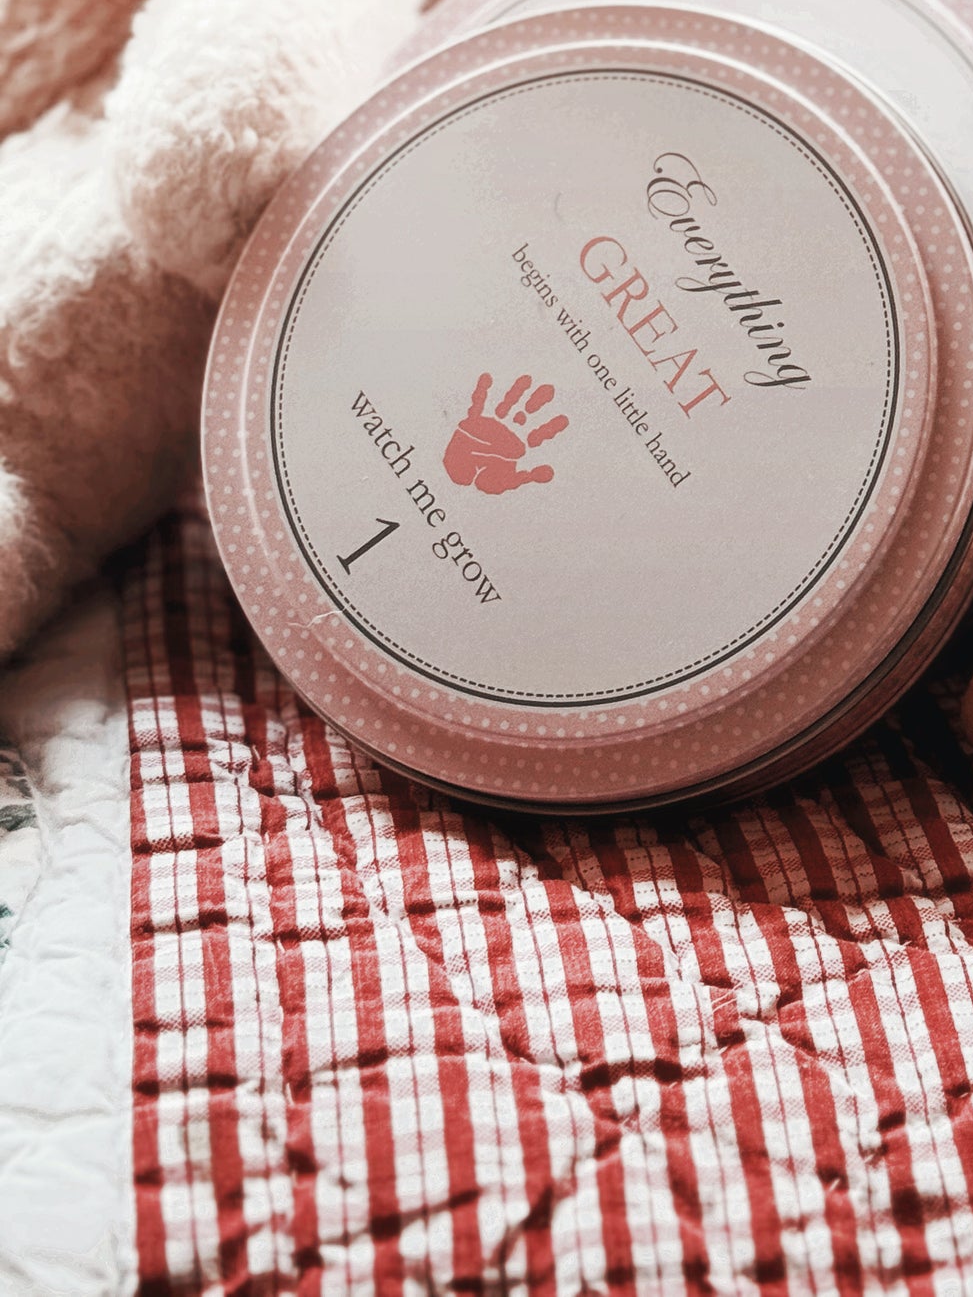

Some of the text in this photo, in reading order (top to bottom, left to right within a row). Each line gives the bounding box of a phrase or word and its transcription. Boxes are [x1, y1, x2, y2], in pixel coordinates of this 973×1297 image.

[511, 242, 692, 488] begins with one little hand
[579, 236, 732, 419] GREAT
[647, 152, 812, 390] Everything
[336, 517, 400, 576] 1
[351, 390, 502, 604] watch me grow
